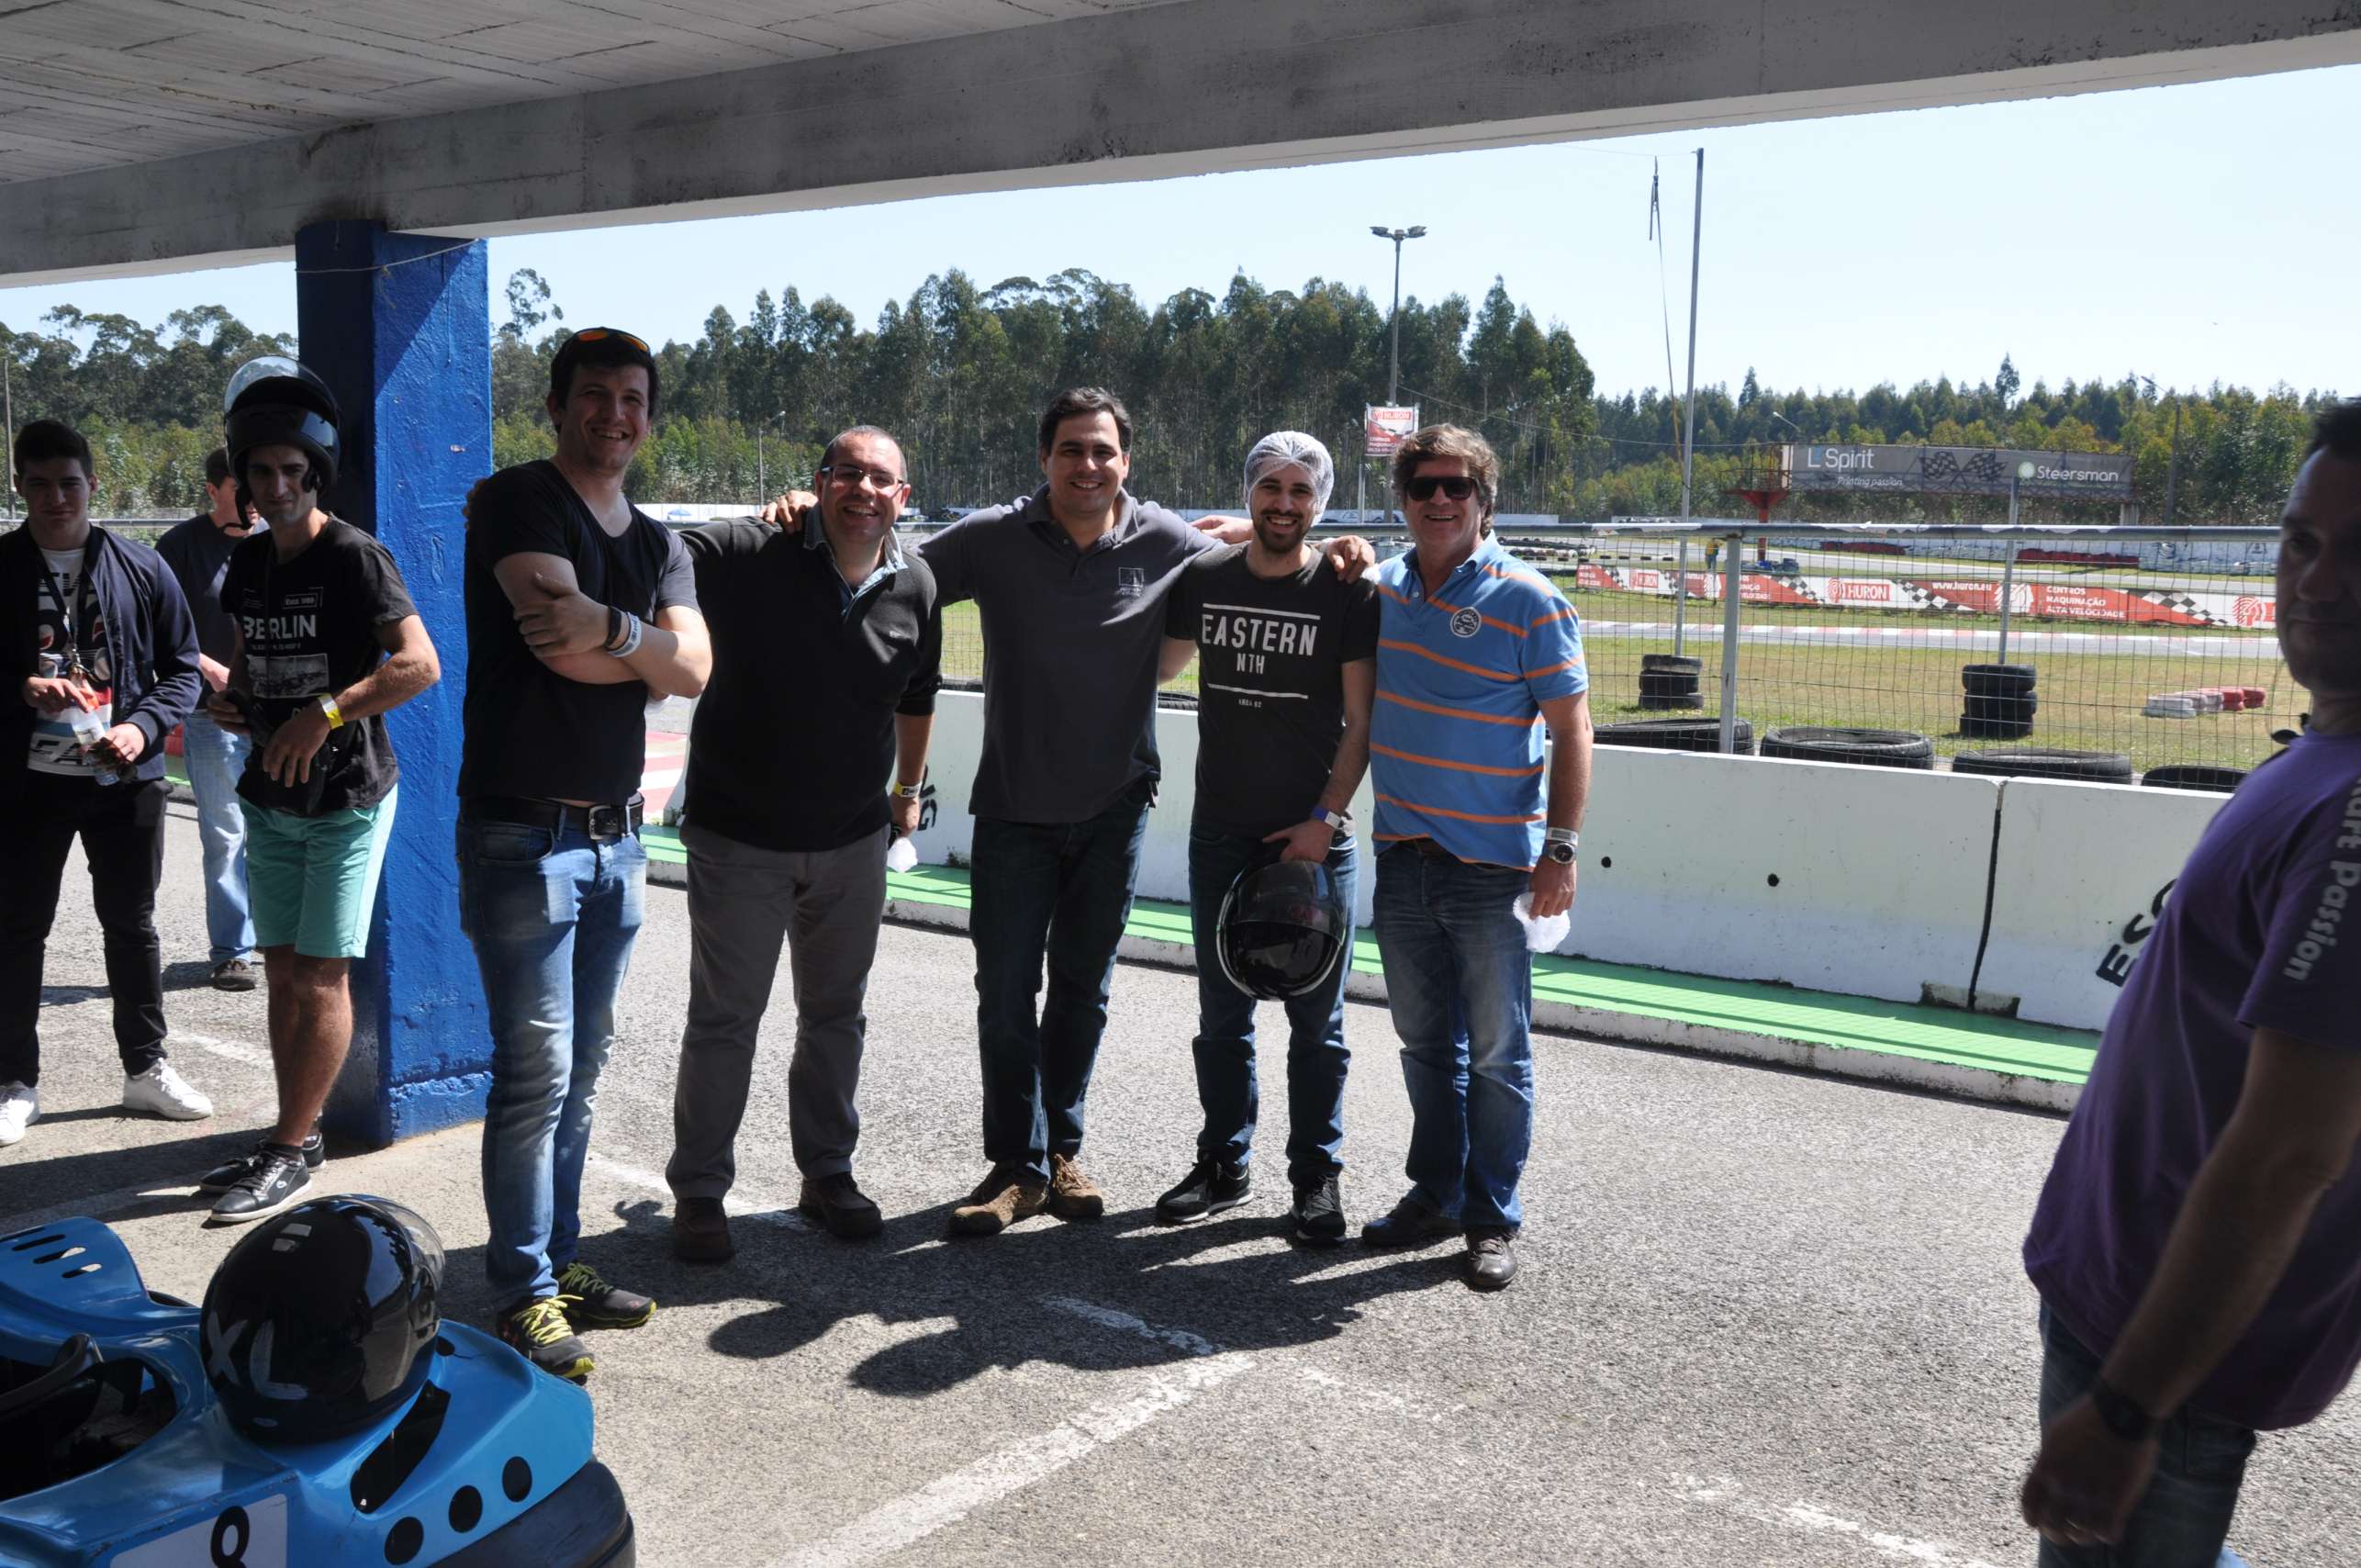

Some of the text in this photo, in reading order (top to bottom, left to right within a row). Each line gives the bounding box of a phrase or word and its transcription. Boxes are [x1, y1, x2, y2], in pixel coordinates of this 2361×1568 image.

[1825, 447, 1875, 473] Spirit
[2036, 465, 2119, 482] Steersman
[1836, 476, 1903, 488] Printing passion
[1847, 584, 1887, 600] HURON
[1931, 580, 1993, 592] www.huron.eu
[2045, 585, 2087, 596] CENTROS
[2045, 595, 2107, 607] MAQUINAÇÃO
[2045, 606, 2126, 619] ALTA VELOCIDADE
[242, 614, 317, 640] BERLIN
[1201, 613, 1318, 656] EASTERN
[1236, 652, 1266, 675] NTH
[206, 1309, 308, 1401] XL
